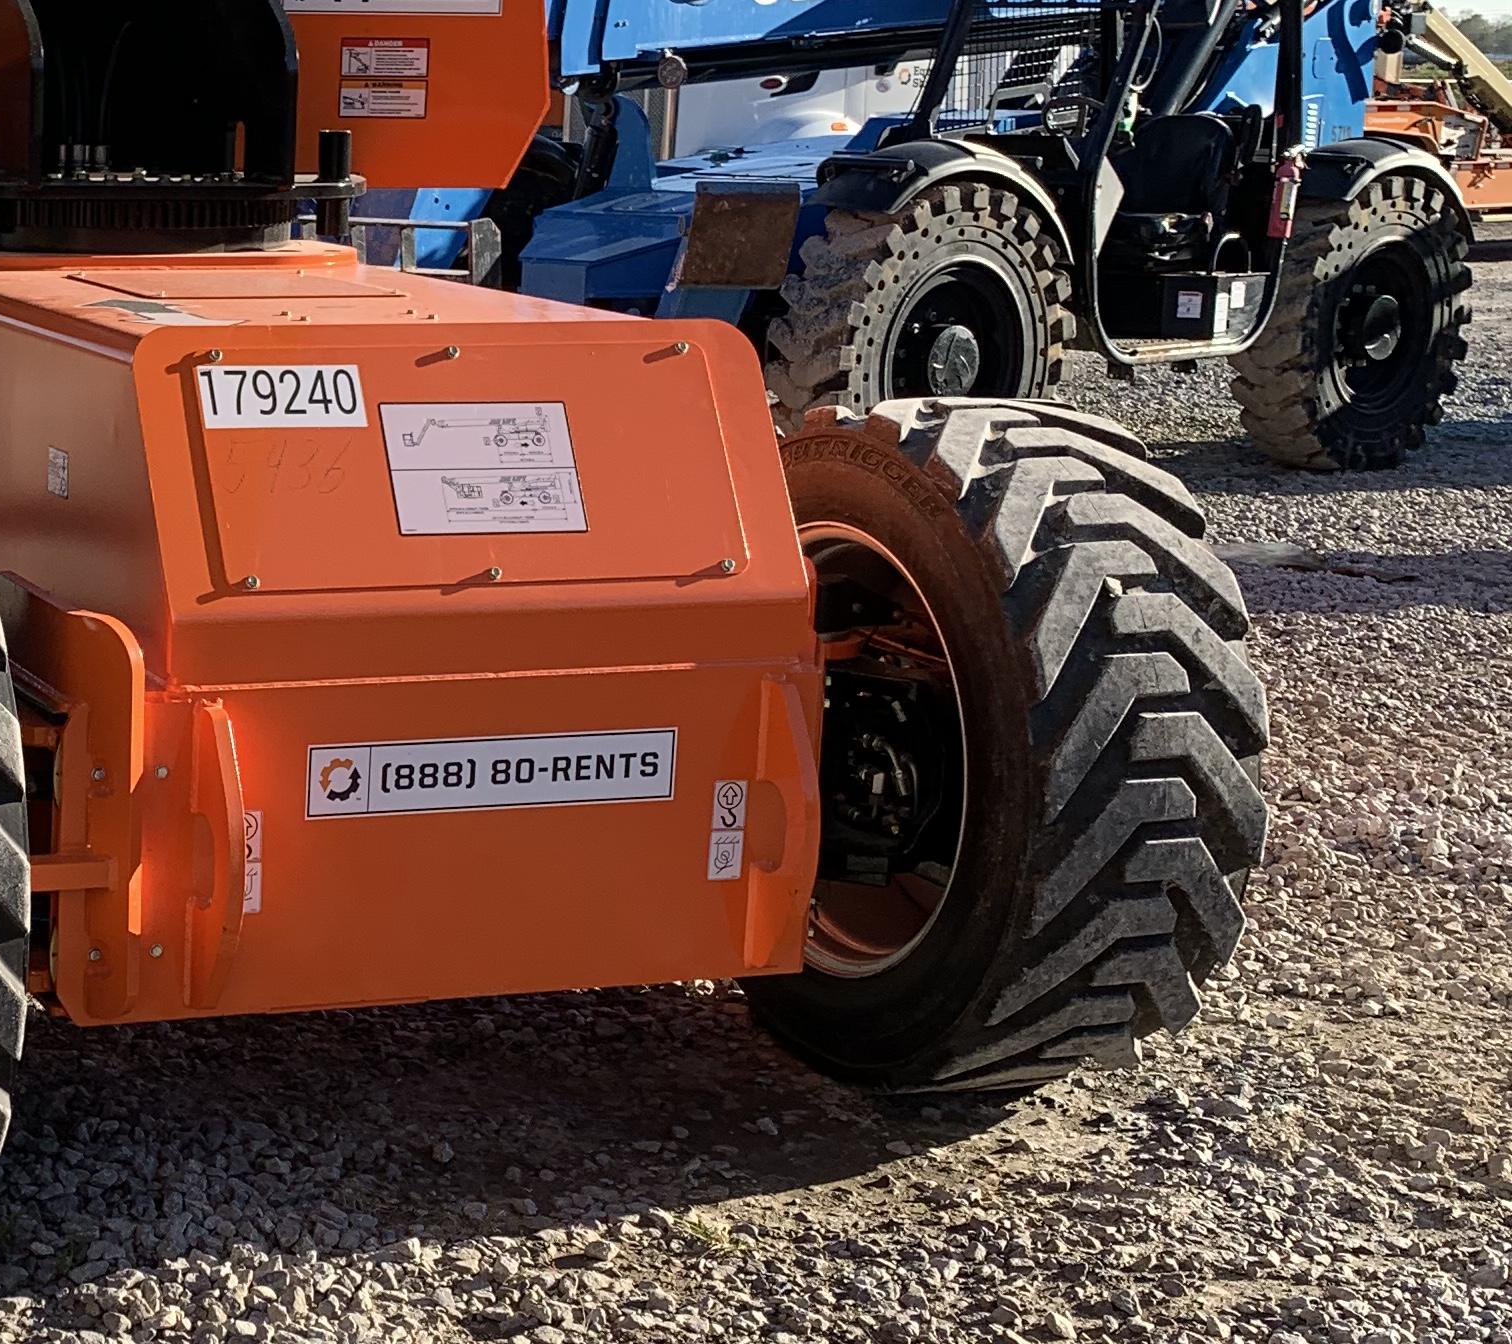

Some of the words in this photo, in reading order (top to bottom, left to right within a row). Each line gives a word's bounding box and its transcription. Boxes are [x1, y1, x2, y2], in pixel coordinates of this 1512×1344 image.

[199, 368, 358, 416] 179240
[381, 758, 476, 793] (888)
[491, 751, 660, 786] 80-RENTS
